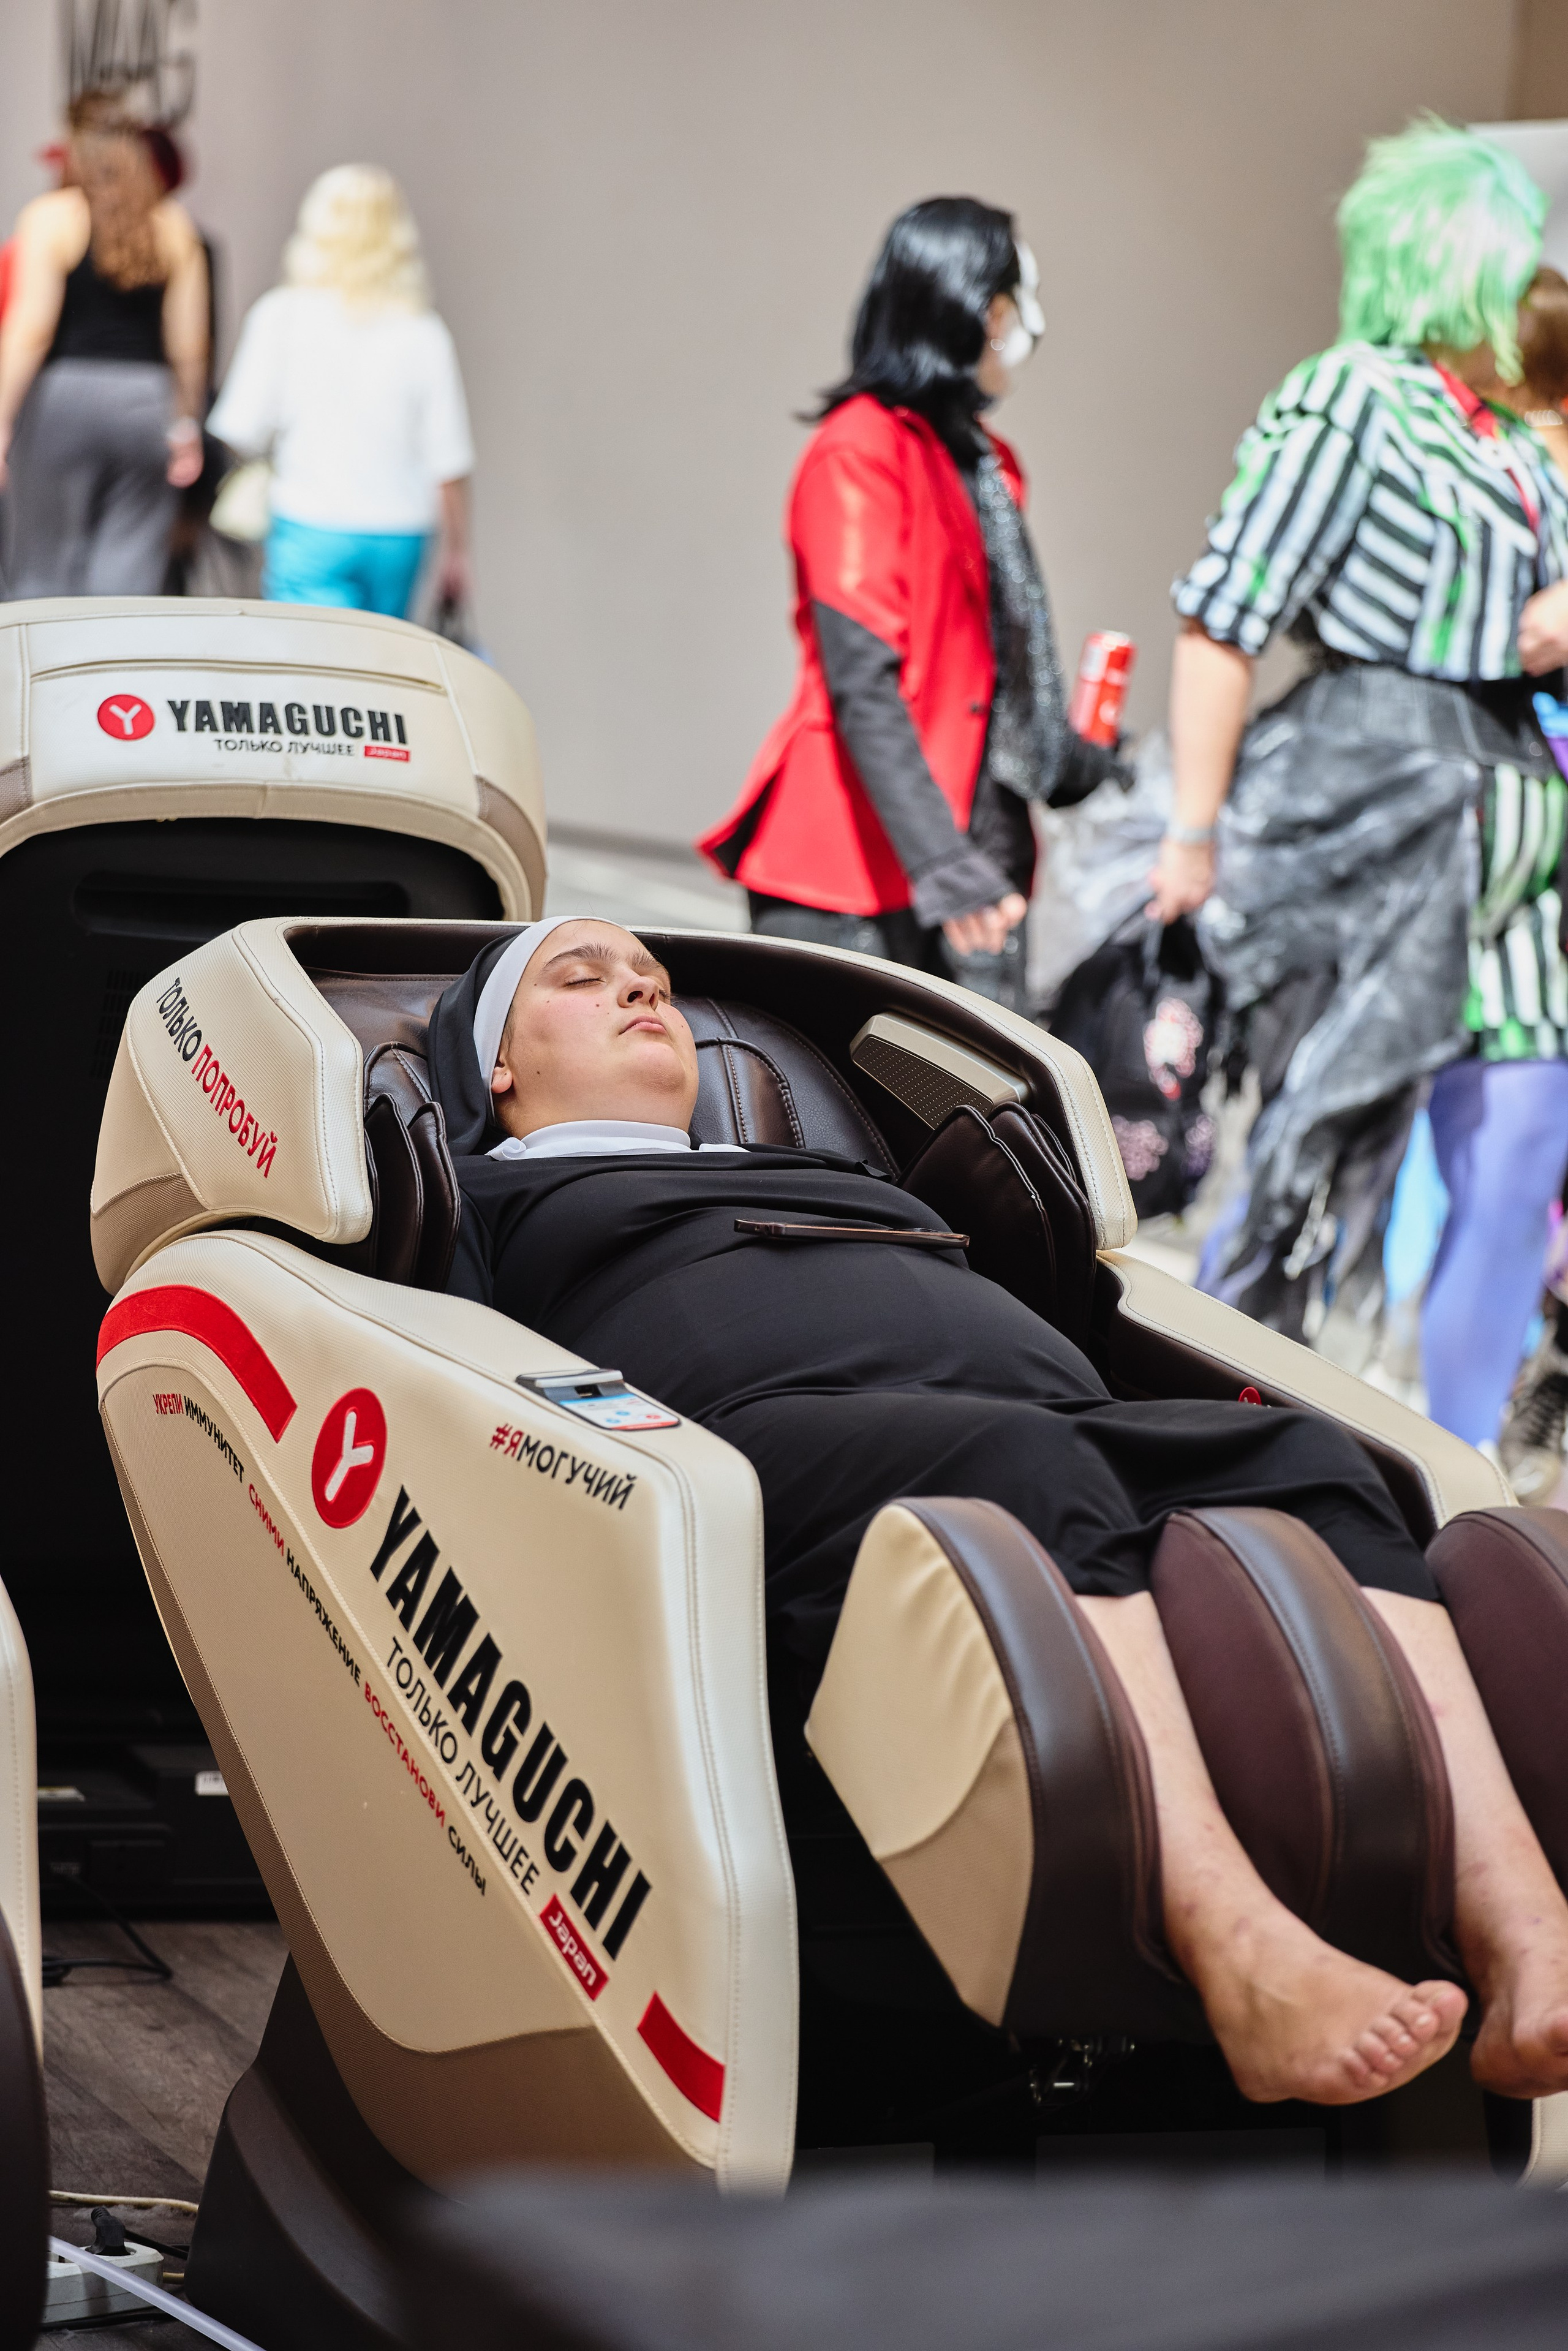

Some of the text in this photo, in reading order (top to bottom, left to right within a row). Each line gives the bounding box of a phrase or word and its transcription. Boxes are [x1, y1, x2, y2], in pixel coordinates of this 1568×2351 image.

[168, 700, 407, 743] YAMAGUCHI
[214, 739, 355, 757] ТОЛЬКО ЛУЧШЕЕ
[156, 977, 278, 1178] ТОЛЬКО ПОПРОБУЙ
[490, 1424, 637, 1510] #ЯМОГУЧИЙ
[153, 1394, 486, 1896] УКРЕПИ ИММУНИТЕТ СНИМИ НАПРЯЖЕНИЕ ВОССТАНОВИ СИЛЫ
[370, 1484, 652, 1961] YAMAGUCHI
[387, 1637, 540, 1896] ТОЛЬКО ЛУЧШЕЕ
[548, 1911, 597, 1987] Japan
